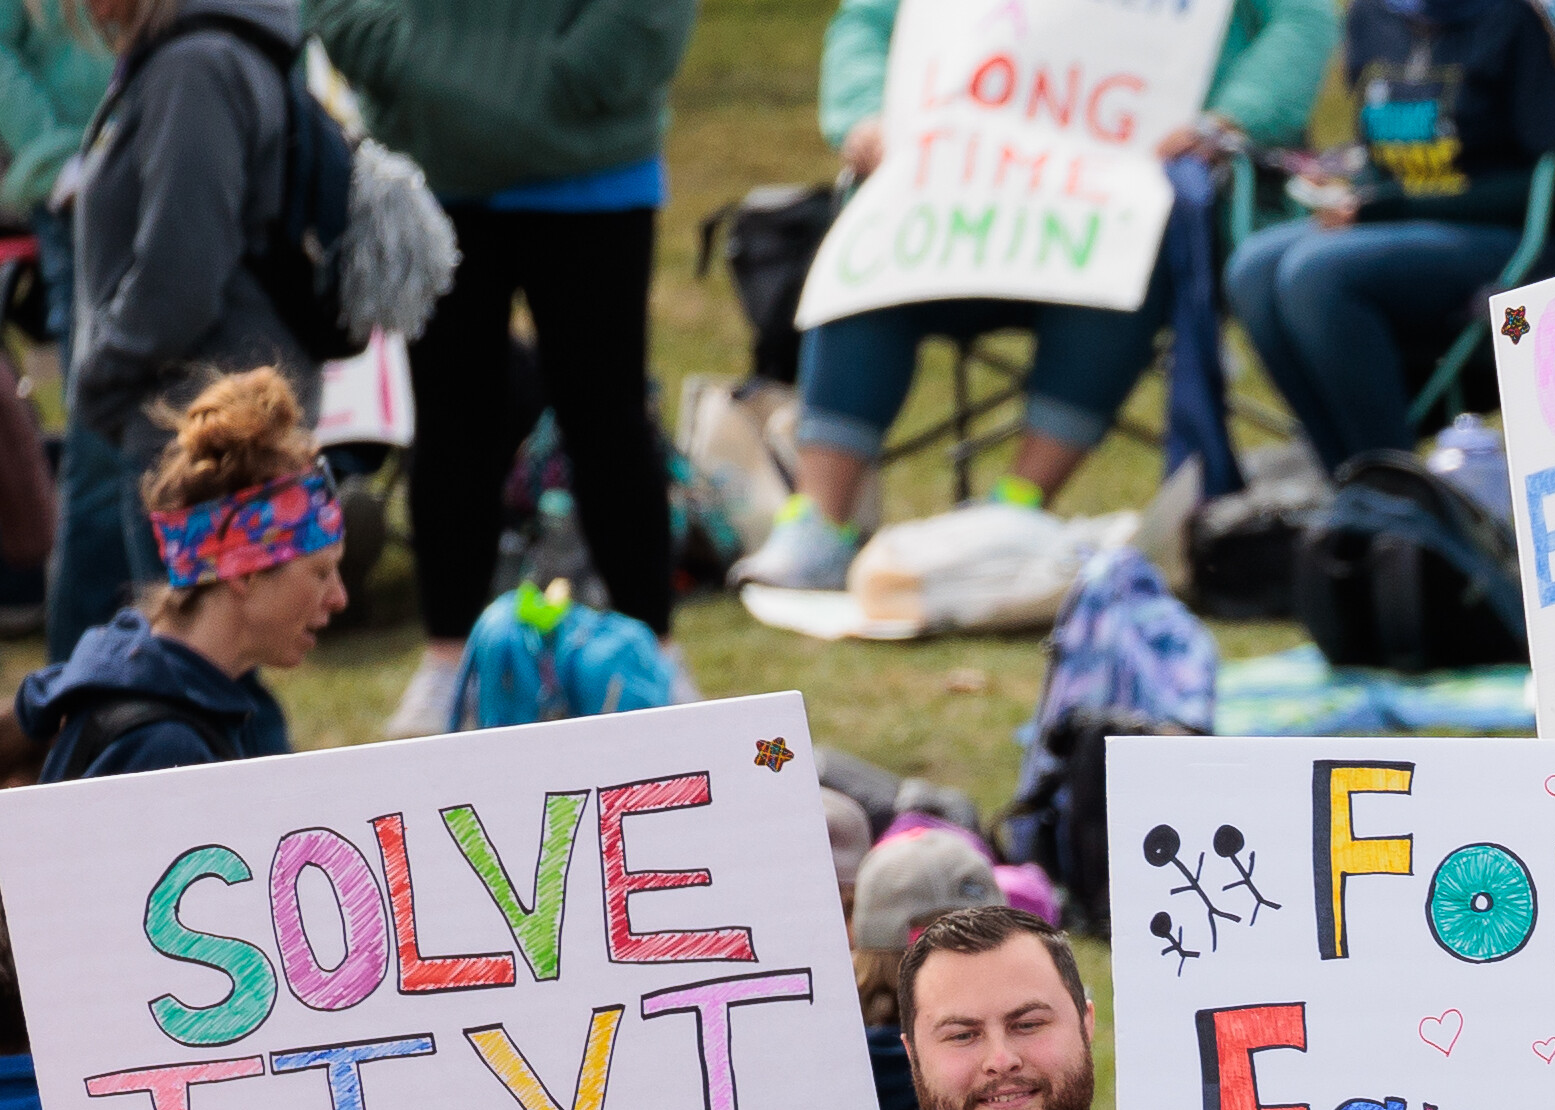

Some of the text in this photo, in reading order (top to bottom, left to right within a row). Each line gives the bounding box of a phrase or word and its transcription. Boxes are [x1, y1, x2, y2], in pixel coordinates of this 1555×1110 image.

[920, 52, 1147, 144] LONG
[914, 126, 1110, 205] TIME
[143, 770, 758, 1046] SOLVE
